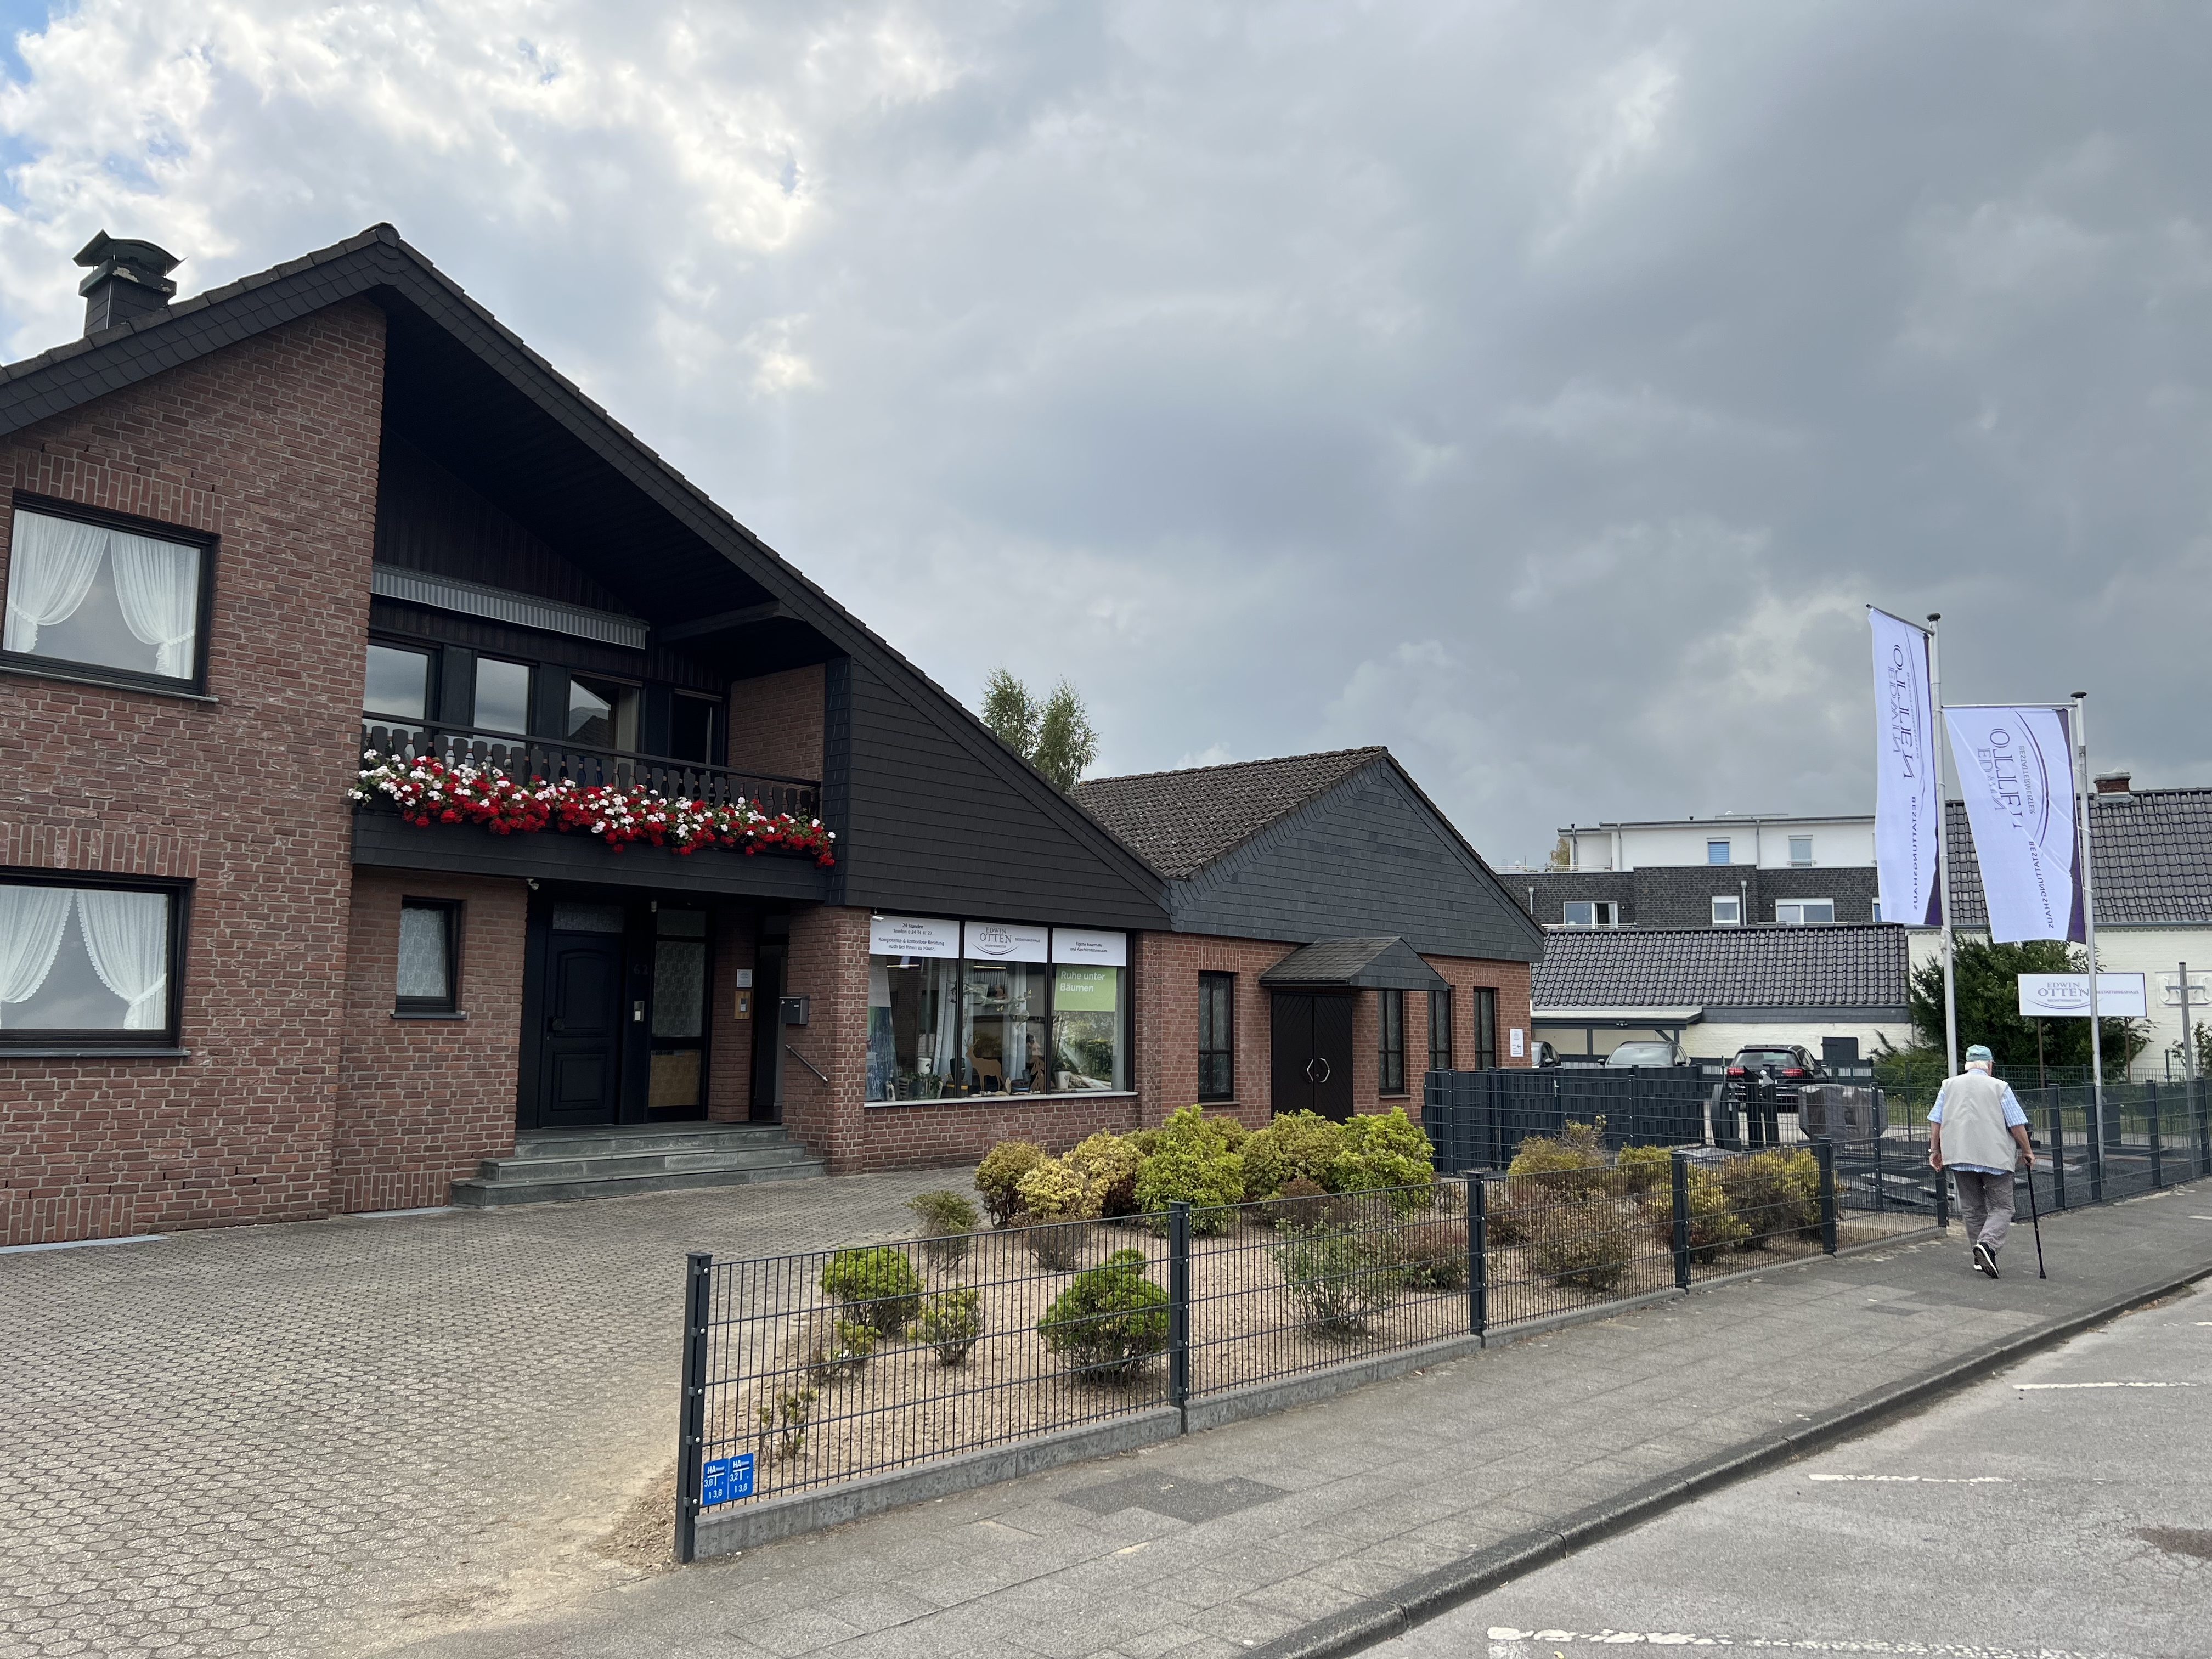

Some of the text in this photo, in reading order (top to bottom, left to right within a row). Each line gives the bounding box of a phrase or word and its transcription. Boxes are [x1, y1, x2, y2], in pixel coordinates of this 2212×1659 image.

[980, 933, 1012, 943] OTTEN
[1061, 970, 1105, 980] Ruhe unter
[1060, 983, 1094, 992] Bäumen
[2038, 988, 2089, 996] OTTEN
[733, 1460, 741, 1469] HA
[707, 1465, 716, 1474] HA
